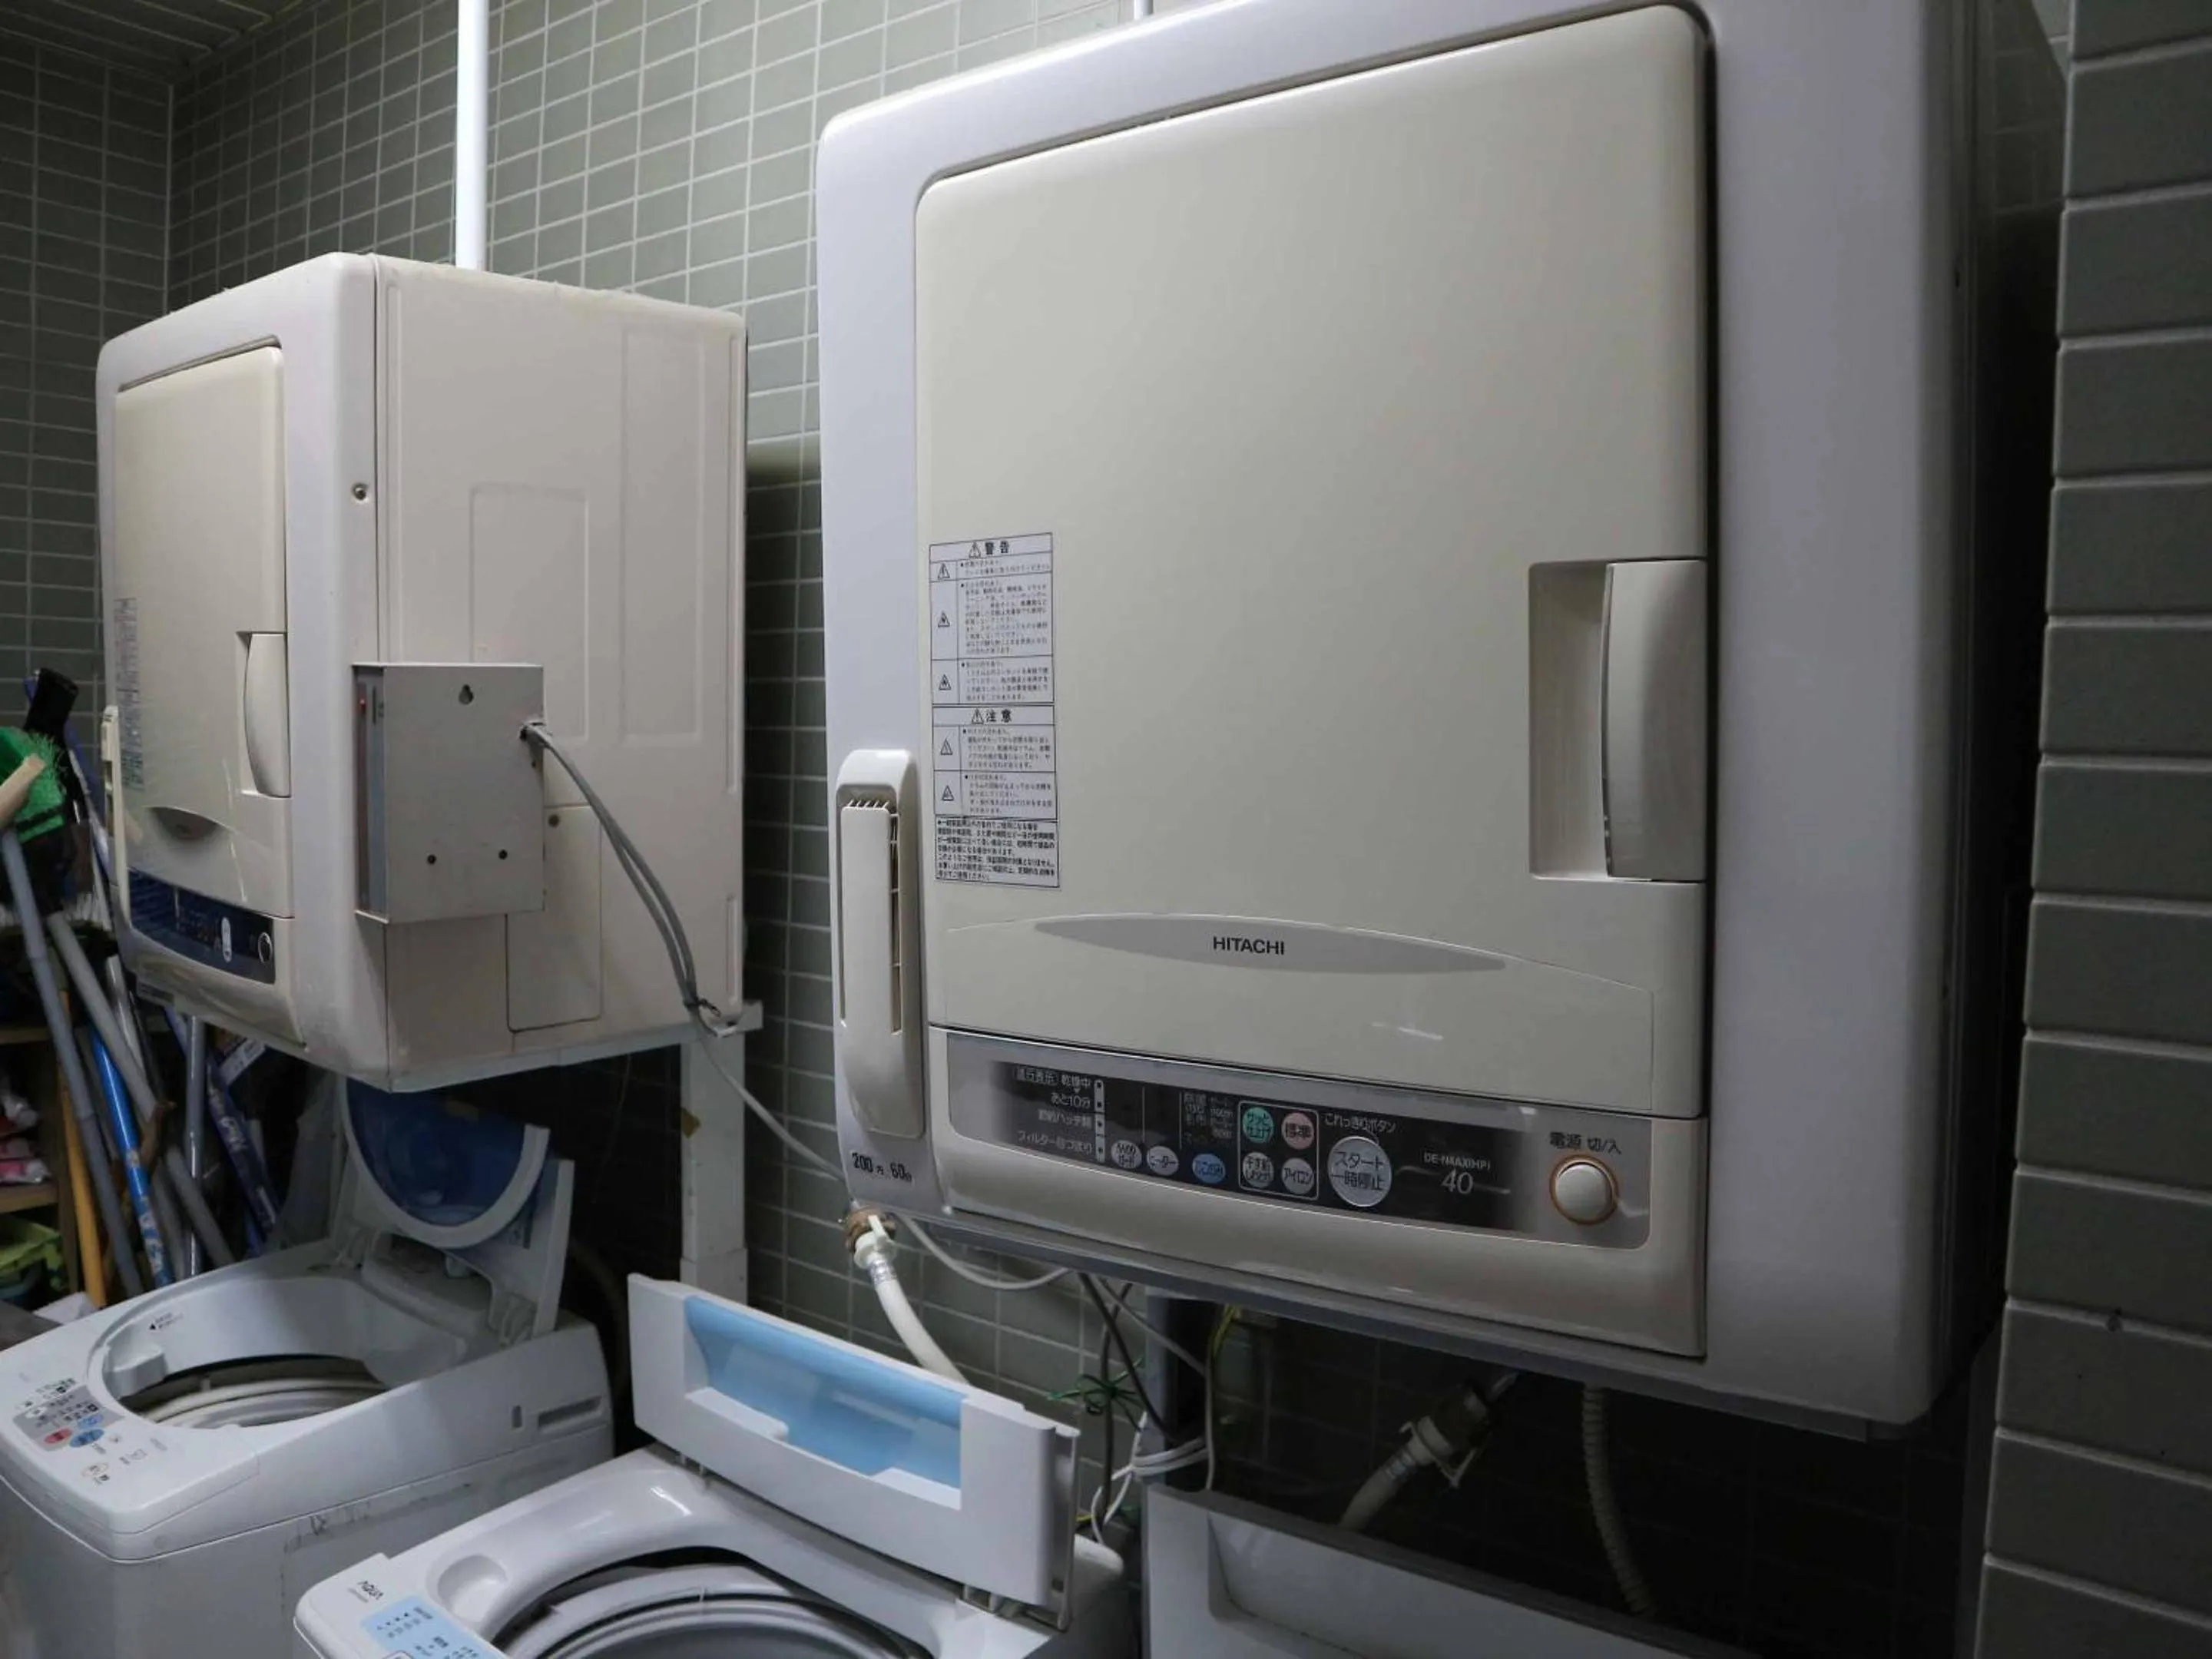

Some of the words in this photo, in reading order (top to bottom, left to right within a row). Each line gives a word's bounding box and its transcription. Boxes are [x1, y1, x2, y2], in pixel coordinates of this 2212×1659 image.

[986, 708, 1012, 723] 注意
[1212, 935, 1286, 955] HITACHI
[1051, 1091, 1091, 1108] あと10分
[1325, 1113, 1396, 1134] これっきりボタン
[1549, 1131, 1582, 1150] 電源
[1587, 1138, 1622, 1154] 切/入
[1333, 1151, 1384, 1171] スタート
[1284, 1167, 1314, 1185] アイロン
[1330, 1170, 1385, 1190] 一時停止
[1440, 1167, 1474, 1195] 40
